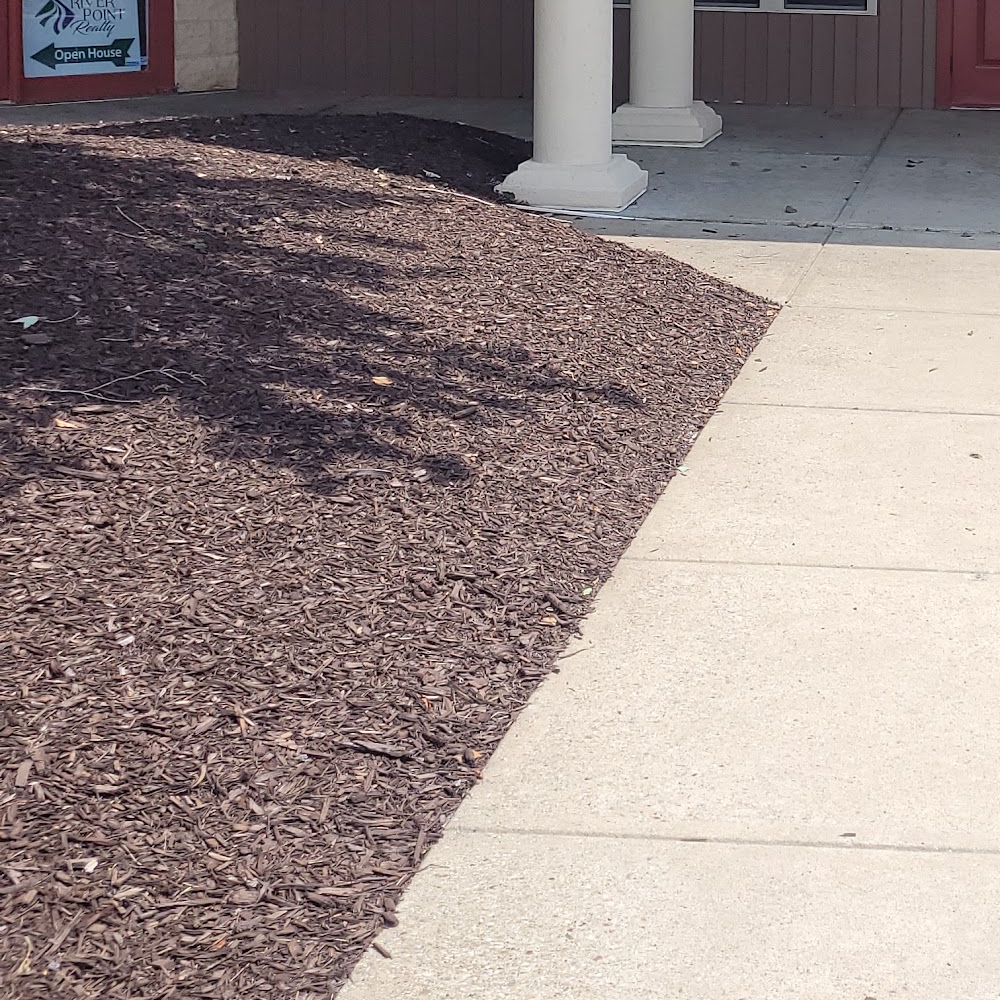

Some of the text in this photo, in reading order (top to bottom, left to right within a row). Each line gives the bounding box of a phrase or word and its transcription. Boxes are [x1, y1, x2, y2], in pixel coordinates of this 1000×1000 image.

[83, 8, 126, 21] POINT
[69, 19, 116, 38] Realty
[54, 47, 122, 62] Open House
